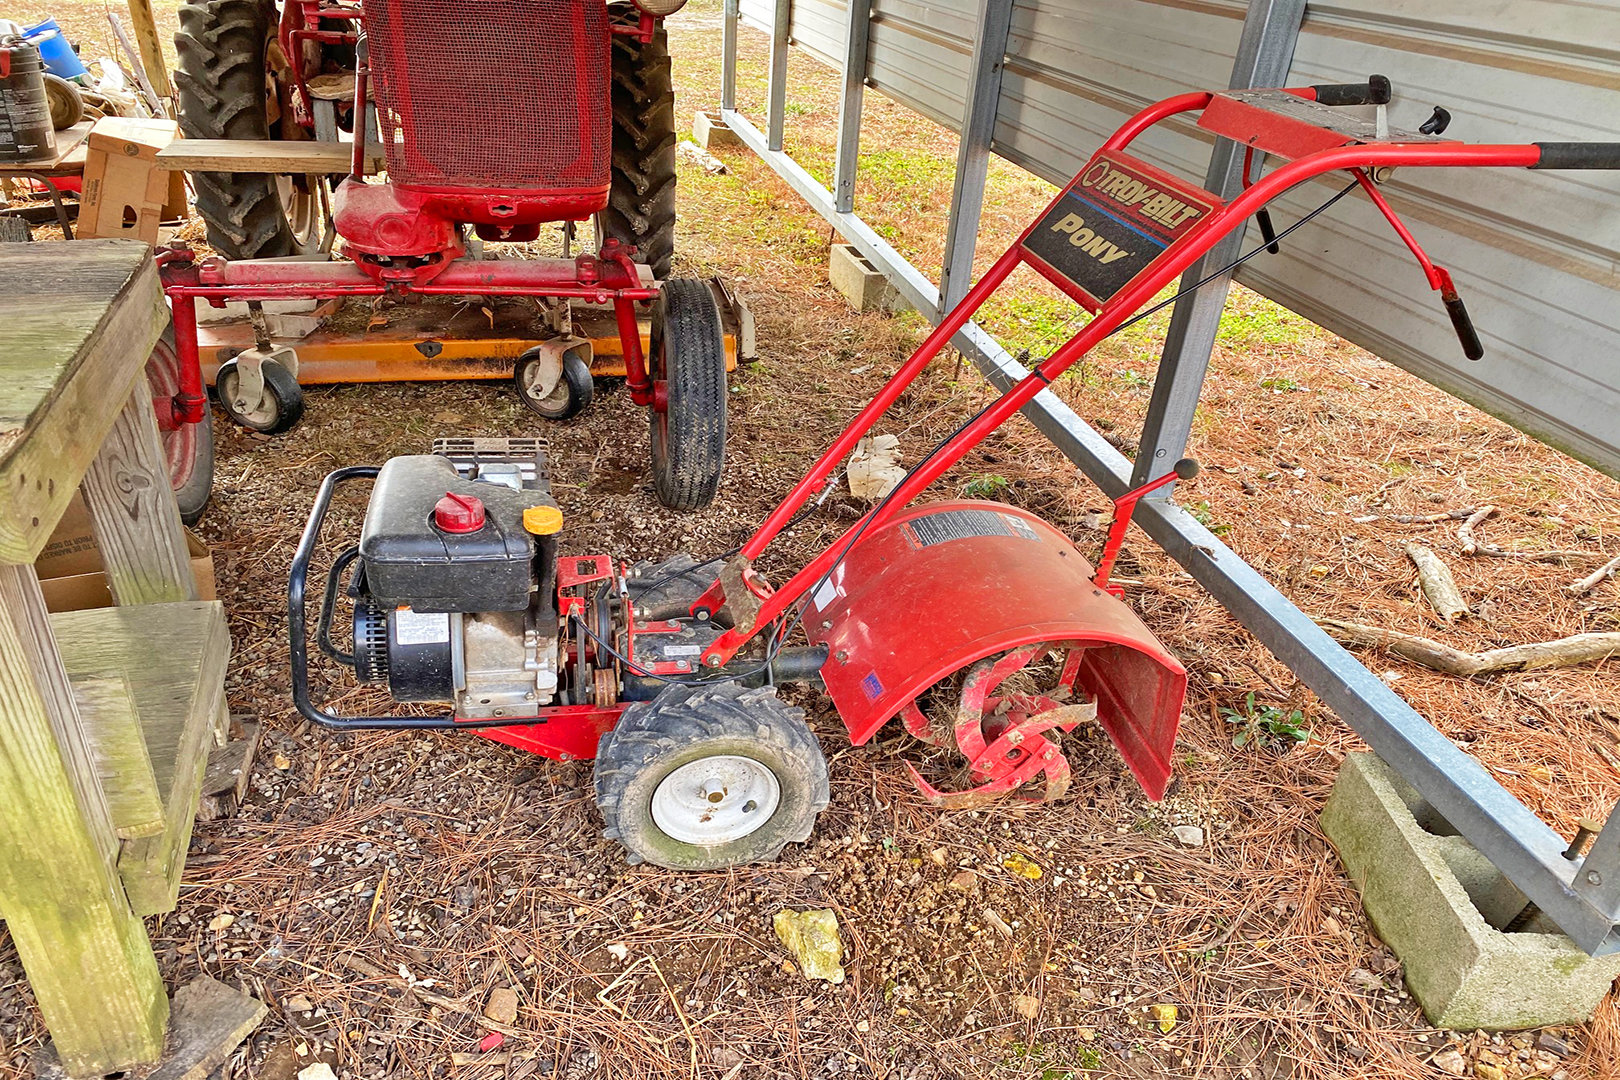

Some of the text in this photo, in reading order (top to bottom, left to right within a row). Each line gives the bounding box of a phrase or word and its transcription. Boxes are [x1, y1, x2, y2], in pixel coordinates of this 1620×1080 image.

[1095, 169, 1200, 230] TROY-BILT
[1050, 212, 1129, 264] PONY
[42, 541, 63, 552] DISPL
[64, 539, 73, 547] TO
